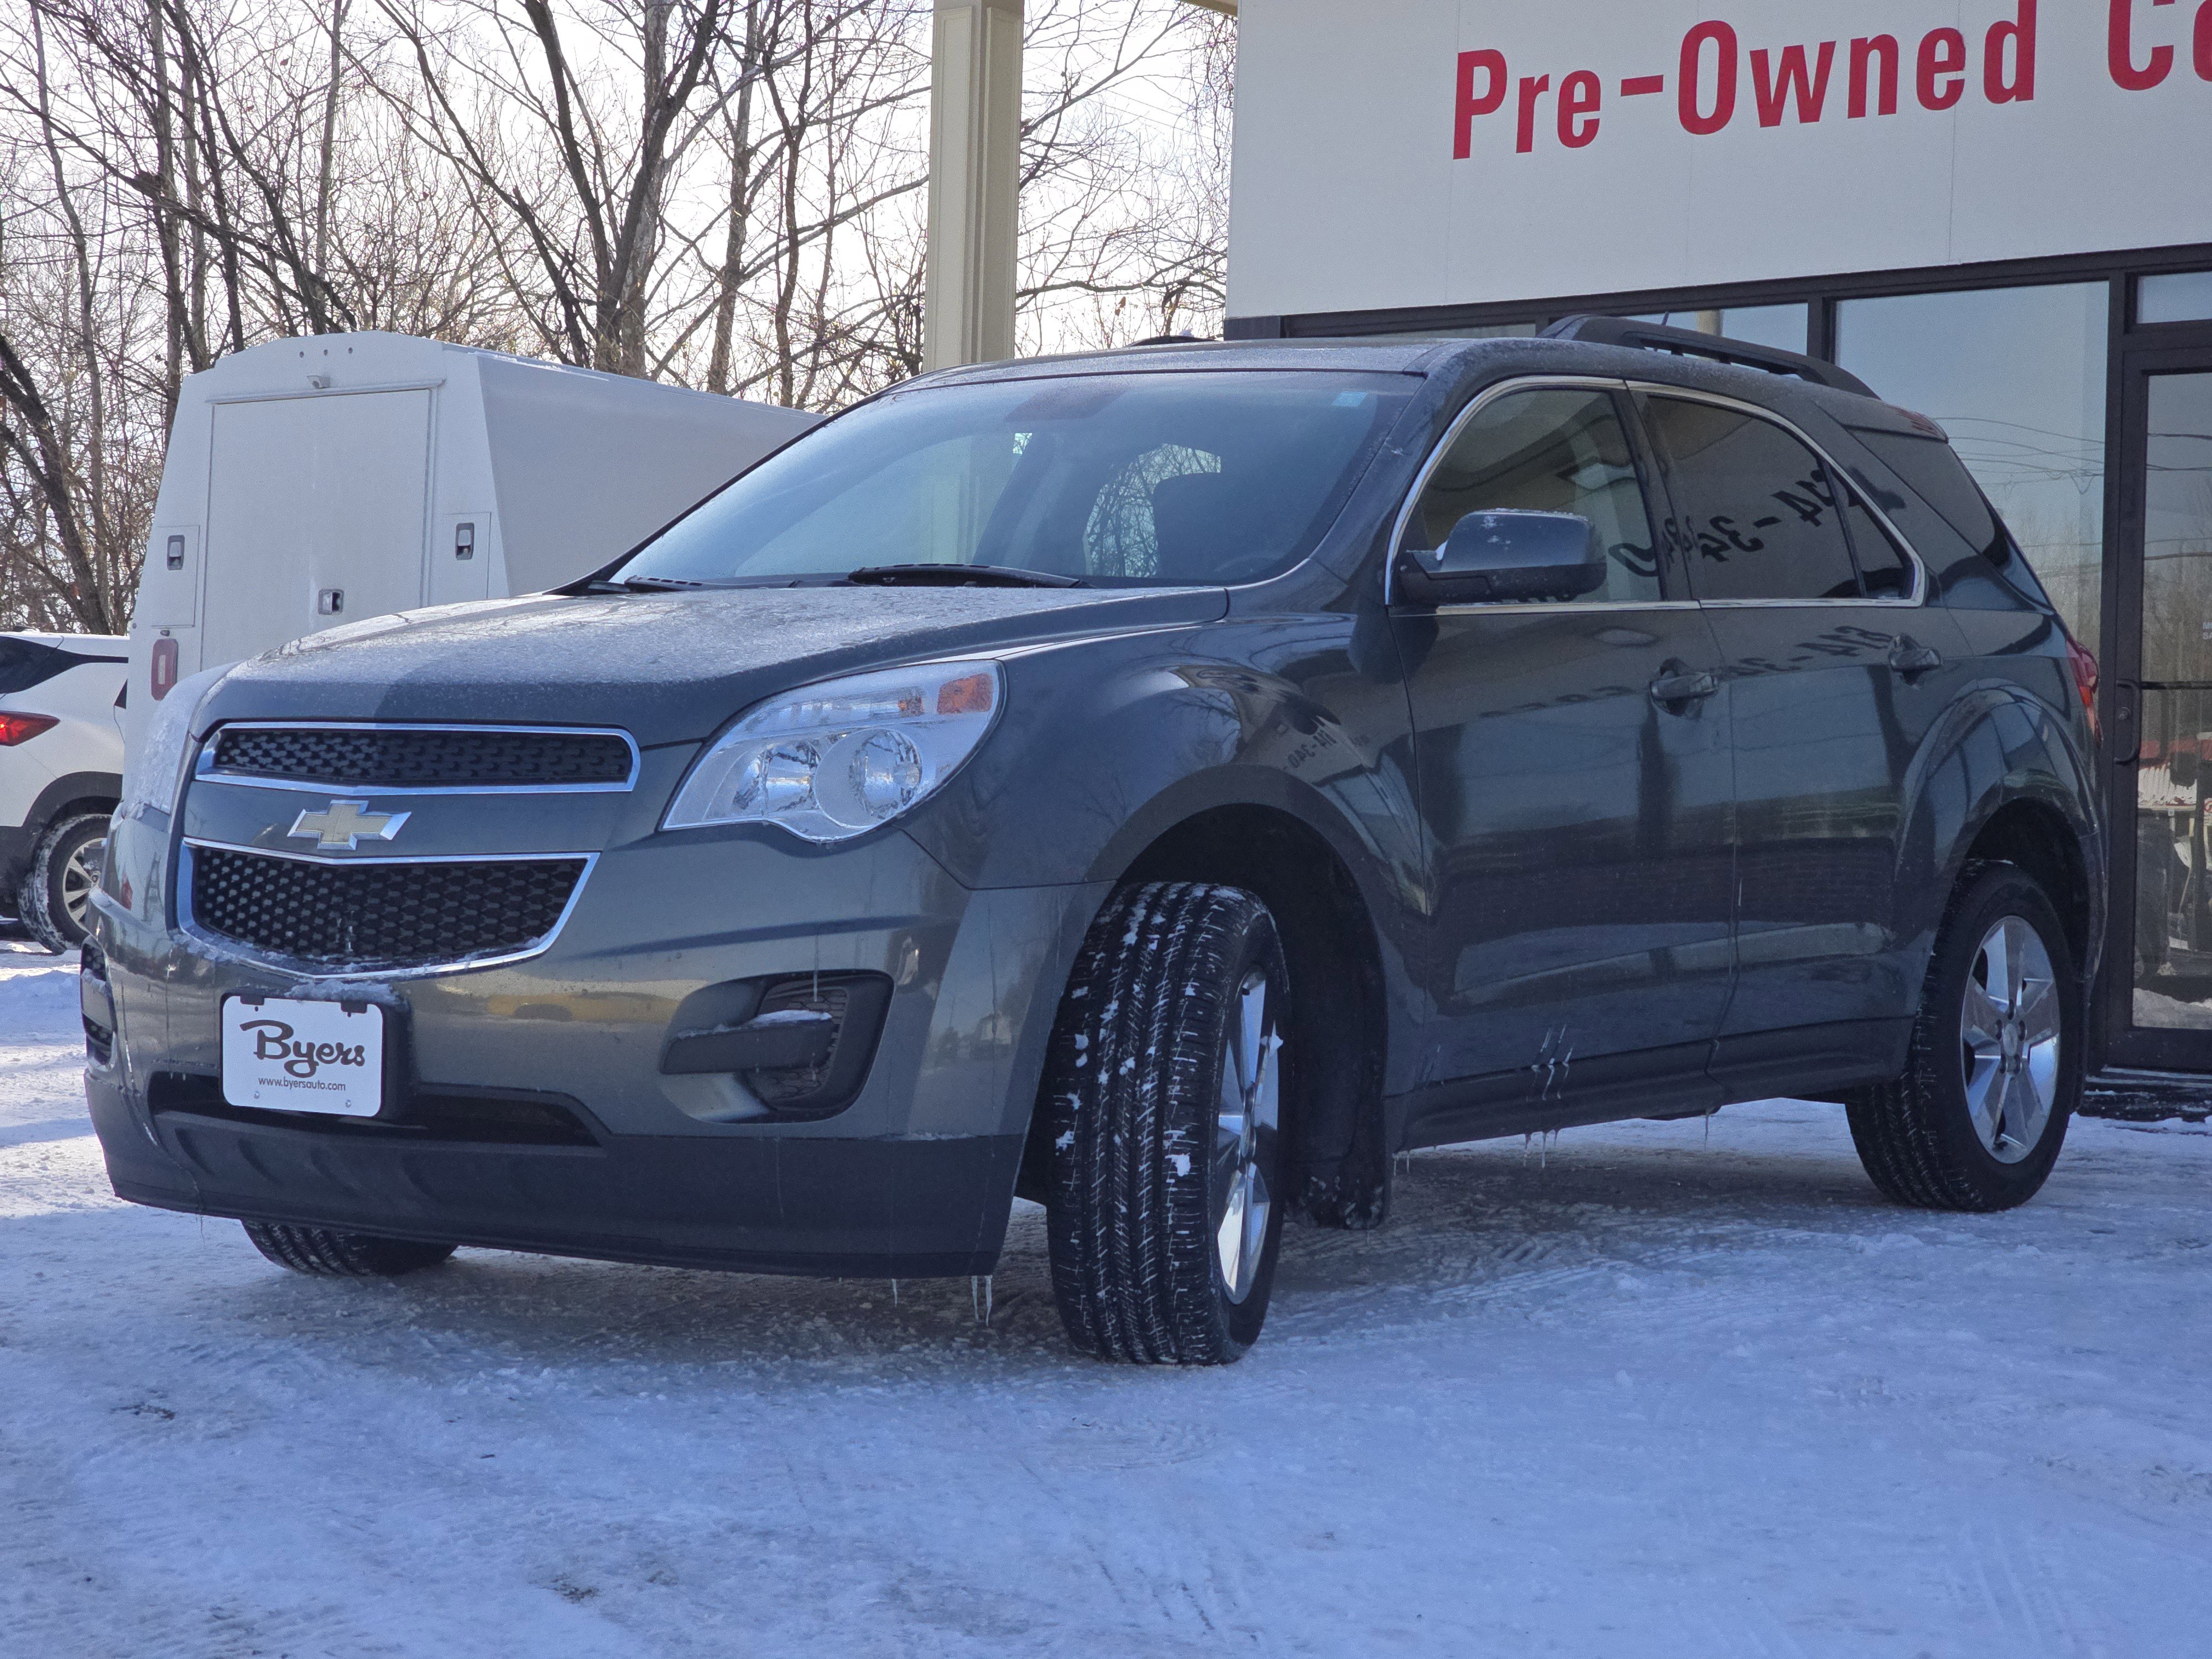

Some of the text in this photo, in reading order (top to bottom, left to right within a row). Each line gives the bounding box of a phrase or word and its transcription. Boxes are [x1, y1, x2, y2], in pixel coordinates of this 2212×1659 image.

[1453, 0, 2036, 159] Pre-Owned
[239, 1020, 365, 1078] Byers
[258, 1077, 346, 1091] www.byersauto.com
